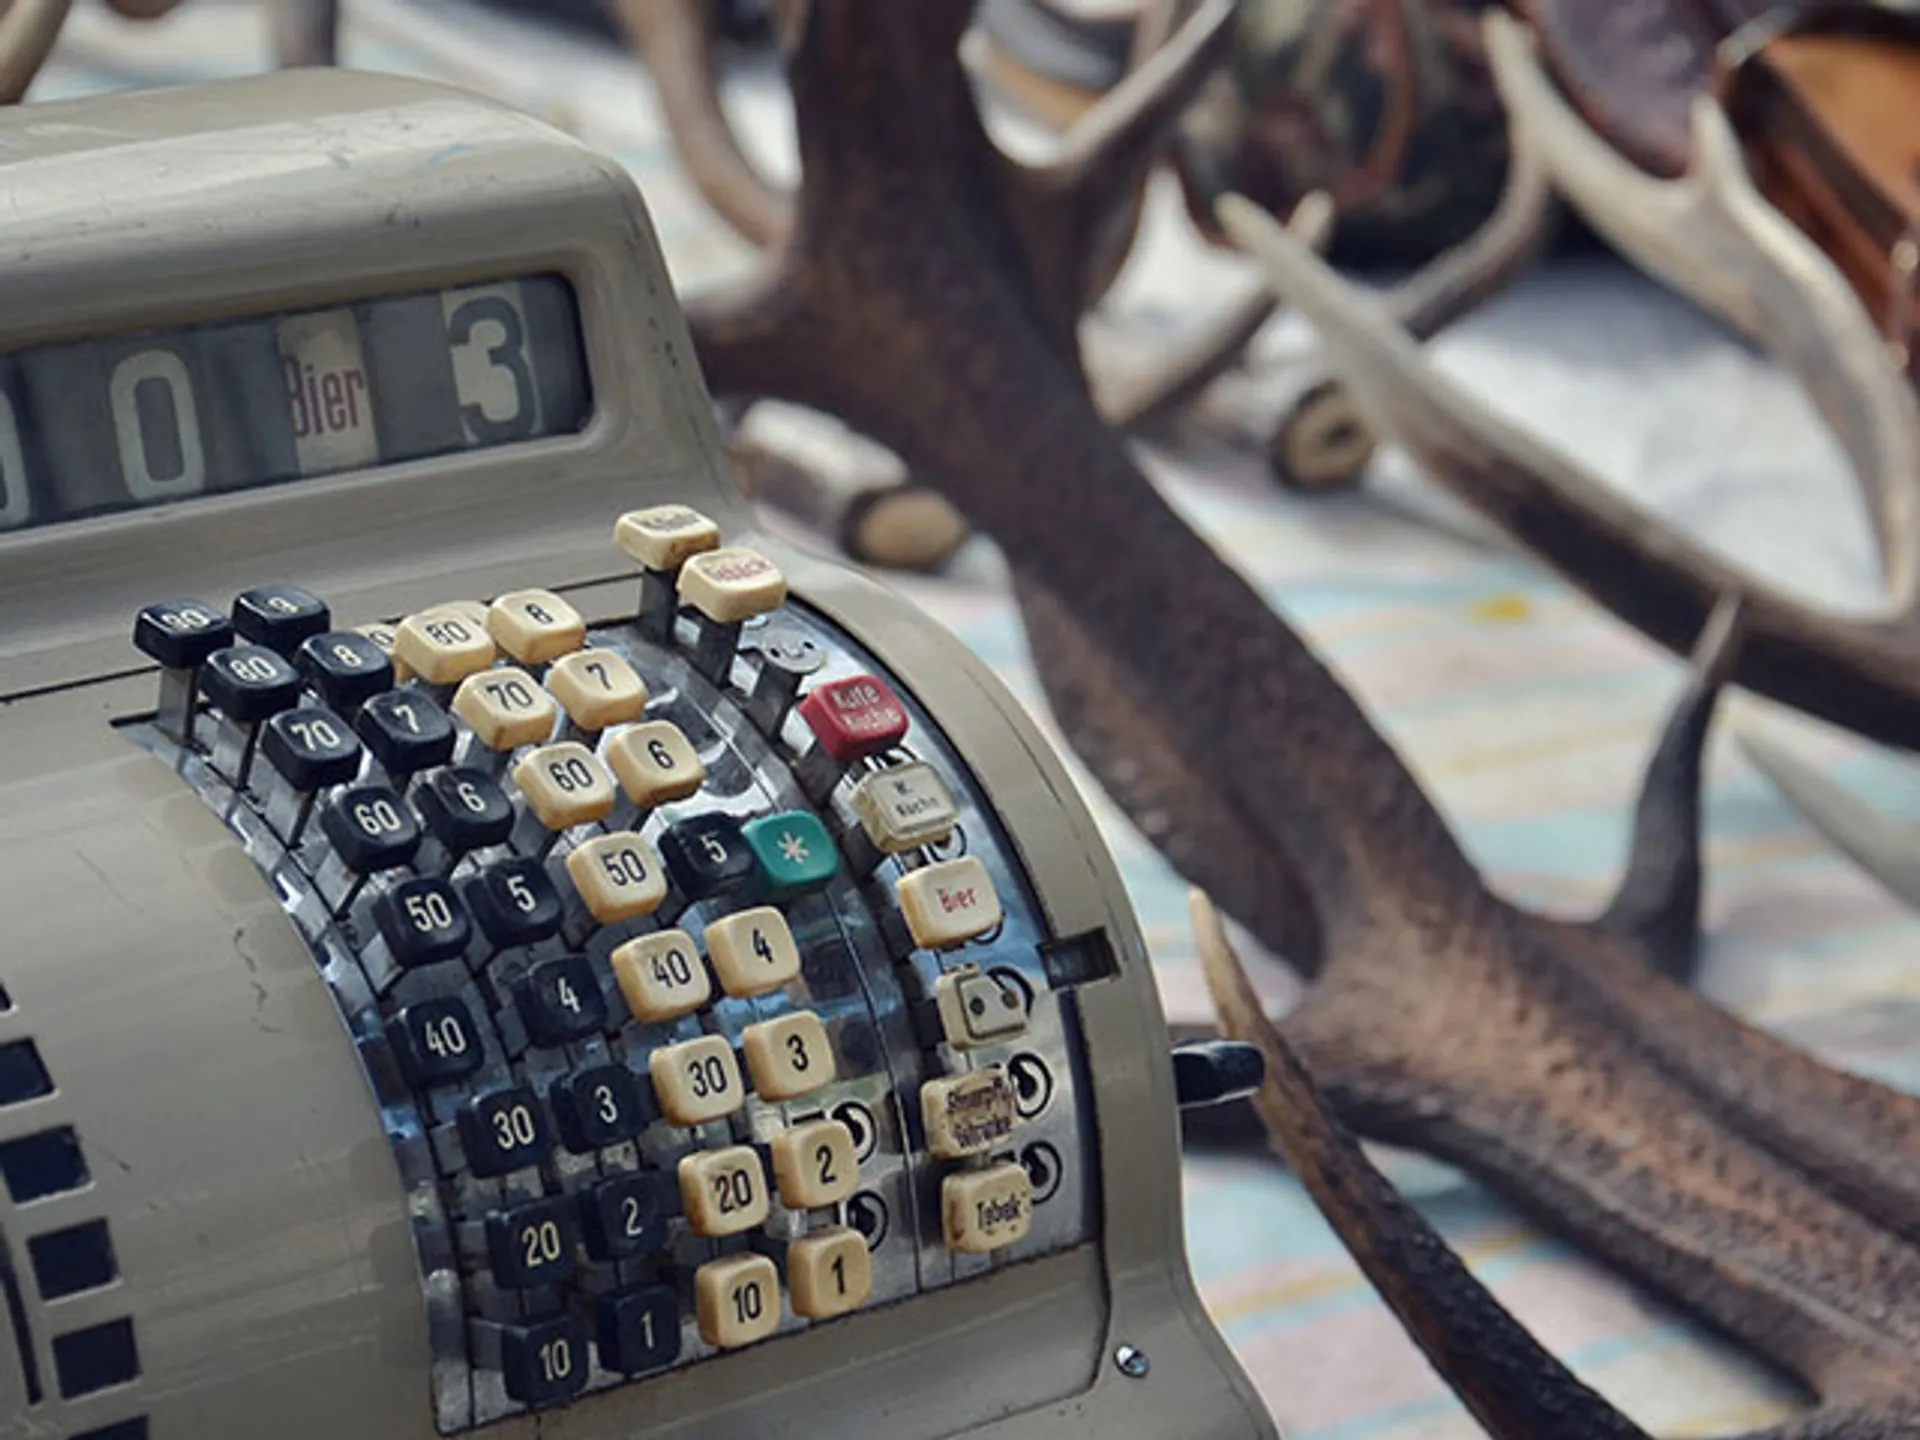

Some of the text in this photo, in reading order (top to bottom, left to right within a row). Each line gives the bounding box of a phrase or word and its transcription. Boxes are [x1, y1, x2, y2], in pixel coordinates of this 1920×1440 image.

[110, 349, 205, 500] 0
[449, 295, 538, 445] 3
[230, 656, 277, 681] 80
[332, 645, 362, 668] 8
[487, 681, 533, 710] 70
[585, 663, 612, 690] 7
[290, 719, 340, 750] 70
[393, 705, 421, 733] 7
[647, 740, 675, 770] 6
[549, 758, 593, 792] 60
[457, 783, 486, 812] 6
[354, 800, 401, 836] 60
[701, 831, 728, 864] 5
[603, 849, 647, 887] 50
[405, 892, 451, 932] 50
[506, 876, 536, 912] 5
[752, 927, 775, 964] 4
[652, 949, 691, 989] 40
[557, 977, 581, 1015] 4
[425, 1016, 467, 1057] 40
[785, 1034, 810, 1072] 3
[687, 1055, 727, 1098] 30
[595, 1085, 618, 1123] 3
[493, 1105, 536, 1150] 30
[816, 1145, 837, 1185] 2
[714, 1169, 751, 1214] 20
[620, 1197, 643, 1236] 2
[522, 1221, 561, 1268] 20
[832, 1255, 846, 1295] 1
[732, 1281, 761, 1324] 10
[640, 1310, 654, 1349] 1
[538, 1339, 572, 1382] 10
